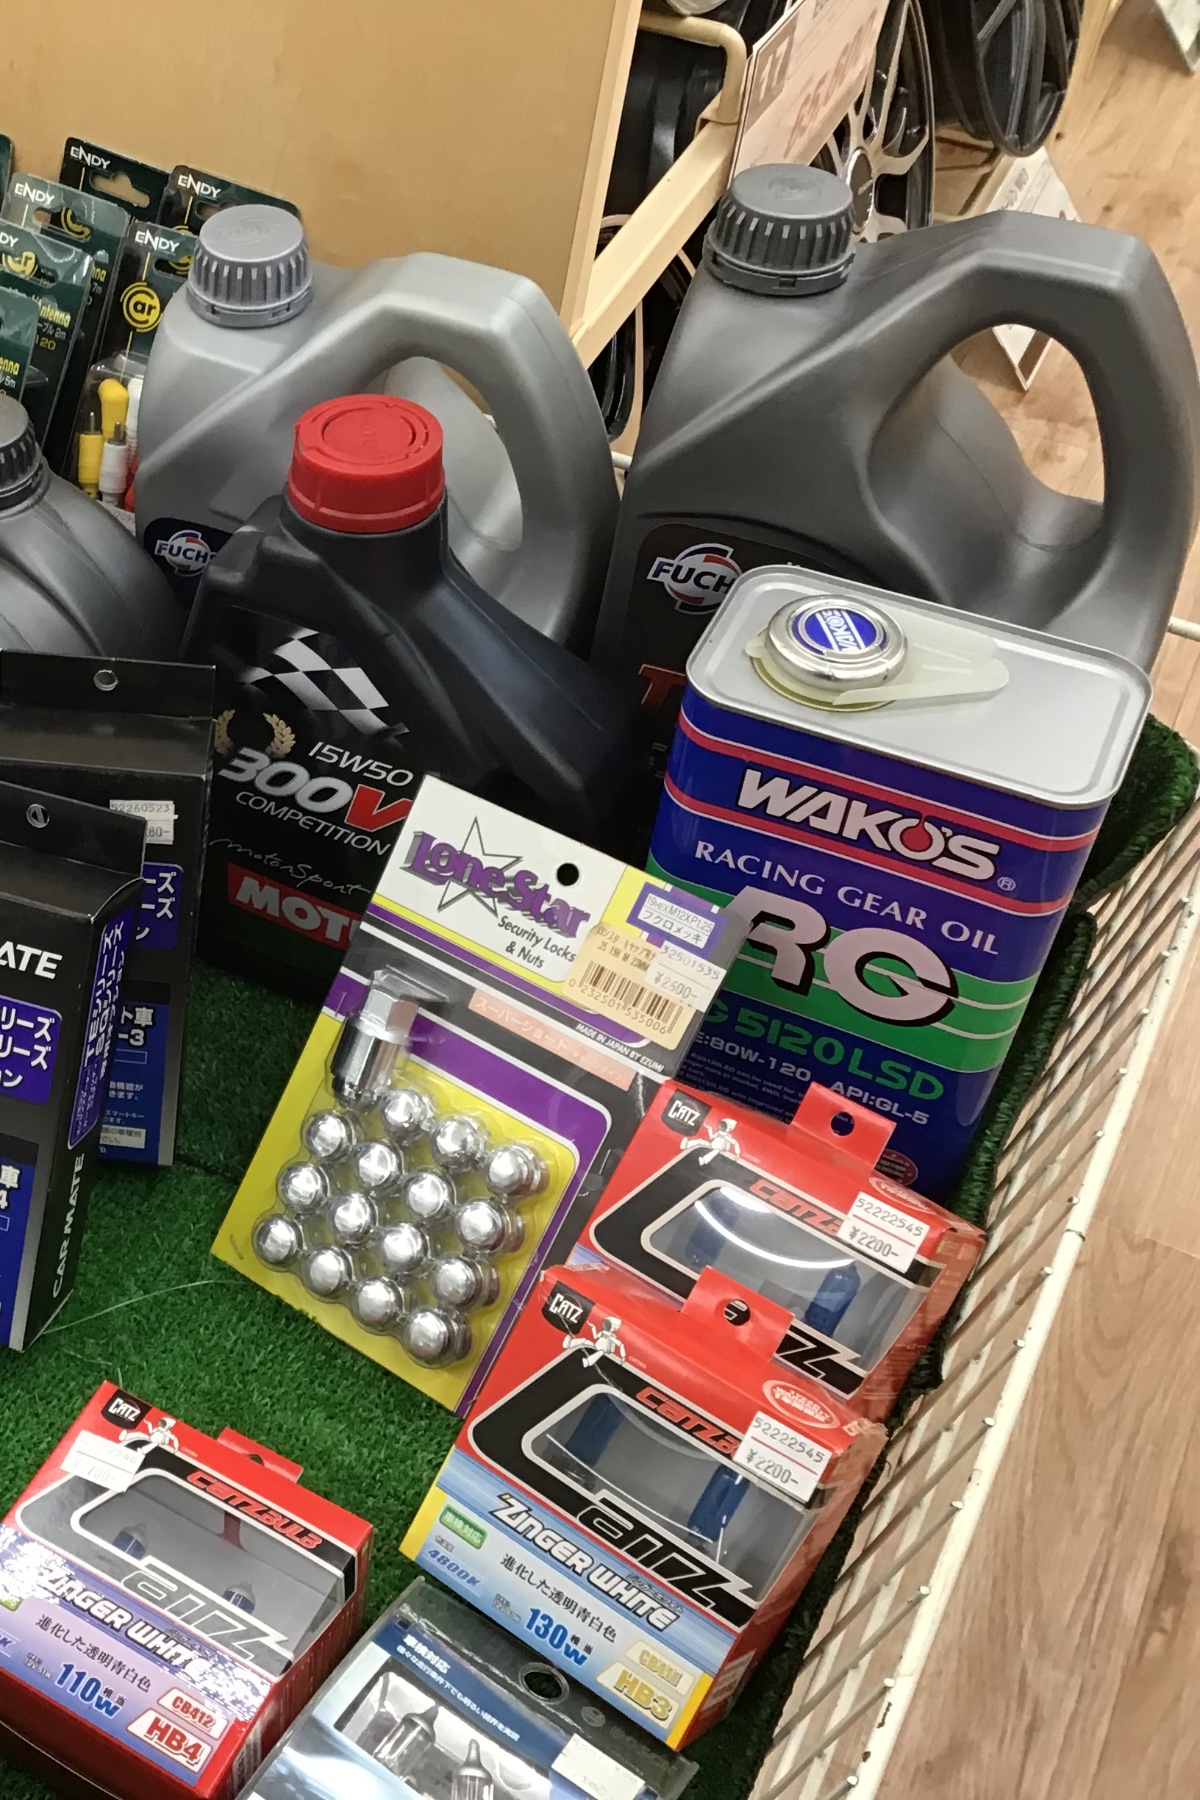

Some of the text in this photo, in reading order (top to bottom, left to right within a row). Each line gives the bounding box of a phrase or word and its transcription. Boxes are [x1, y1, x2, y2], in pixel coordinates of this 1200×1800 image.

[70, 145, 111, 170] ENDY
[14, 181, 56, 205] ENDY
[177, 173, 222, 198] ENDY
[134, 228, 181, 253] ENDY
[651, 559, 738, 596] FUCH
[307, 741, 415, 787] 15W50
[218, 746, 414, 833] 300V
[235, 790, 391, 857] COMPETITION
[736, 766, 1001, 883] WAKO'S
[235, 874, 363, 944] MOT
[694, 840, 999, 957] RACING GEAR OIL
[497, 915, 578, 963] Security Locks
[642, 910, 704, 945] フクロメッキ
[505, 941, 546, 970] & Nuts
[658, 945, 722, 981] 32501535
[725, 884, 960, 1027] RG
[652, 970, 698, 1001] ¥2600-
[580, 986, 622, 1012] 232501
[624, 1007, 668, 1035] 535006
[575, 1022, 666, 1073] MADE IN JAPAN BY EZUMI
[830, 1078, 930, 1126] API:GL-5
[855, 1196, 925, 1239] 52222545
[848, 1224, 900, 1260] ¥2200-
[107, 1398, 142, 1421] CATZ
[752, 1415, 827, 1465] 52222545
[745, 1447, 800, 1488] ¥2200-
[425, 1547, 484, 1588] 4800K
[488, 1493, 685, 1634] ZINGER WHITE
[499, 1552, 618, 1643] 進化した透明青白色
[34, 1613, 152, 1693] 進化した透明青白色
[170, 1694, 218, 1730] CB412
[615, 1667, 673, 1721] HB3
[144, 1717, 204, 1764] HB4
